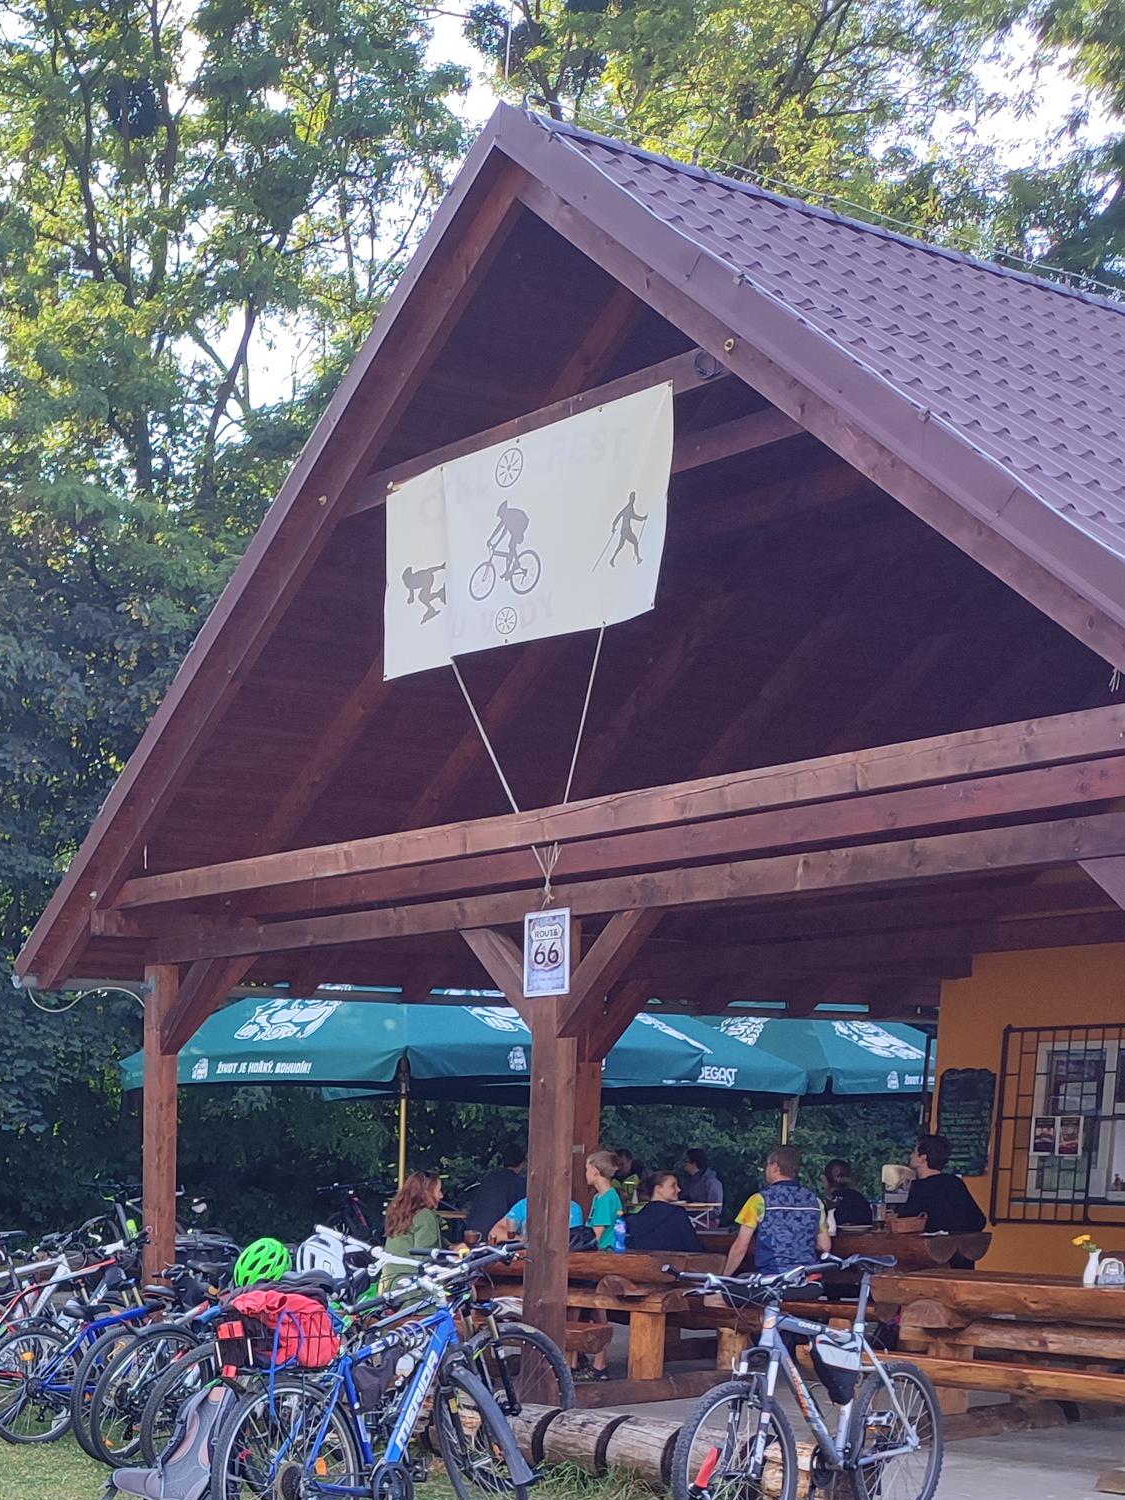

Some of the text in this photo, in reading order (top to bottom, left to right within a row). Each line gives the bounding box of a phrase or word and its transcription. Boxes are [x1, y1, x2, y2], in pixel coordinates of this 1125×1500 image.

[535, 928, 558, 938] ROUTE
[534, 941, 559, 965] 66
[216, 1060, 313, 1074] ŽIVOT JE HOŘKÝ. BOHUDÍK!
[396, 1350, 438, 1451] MERIDA
